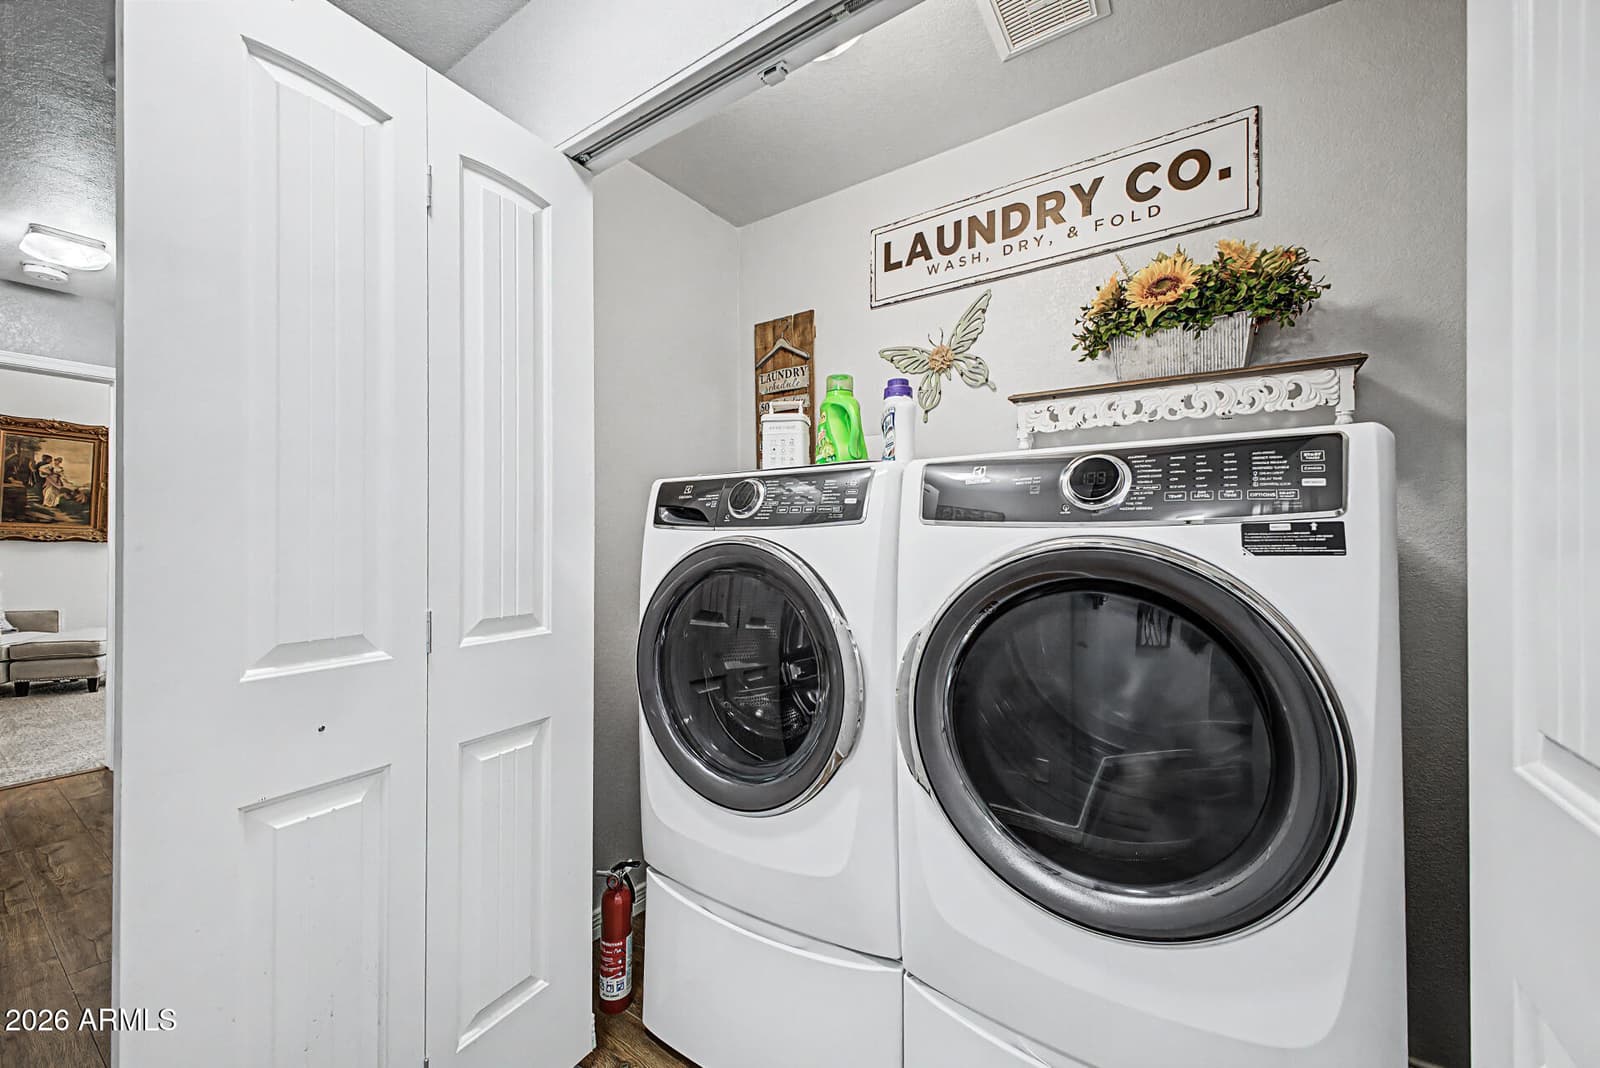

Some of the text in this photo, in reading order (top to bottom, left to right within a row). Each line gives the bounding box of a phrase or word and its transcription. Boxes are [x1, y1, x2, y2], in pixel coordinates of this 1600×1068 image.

[883, 148, 1232, 273] LAUNDRY CO.
[926, 204, 1161, 276] WASH, DRY, & FOLD
[760, 365, 809, 385] LAUNDRY
